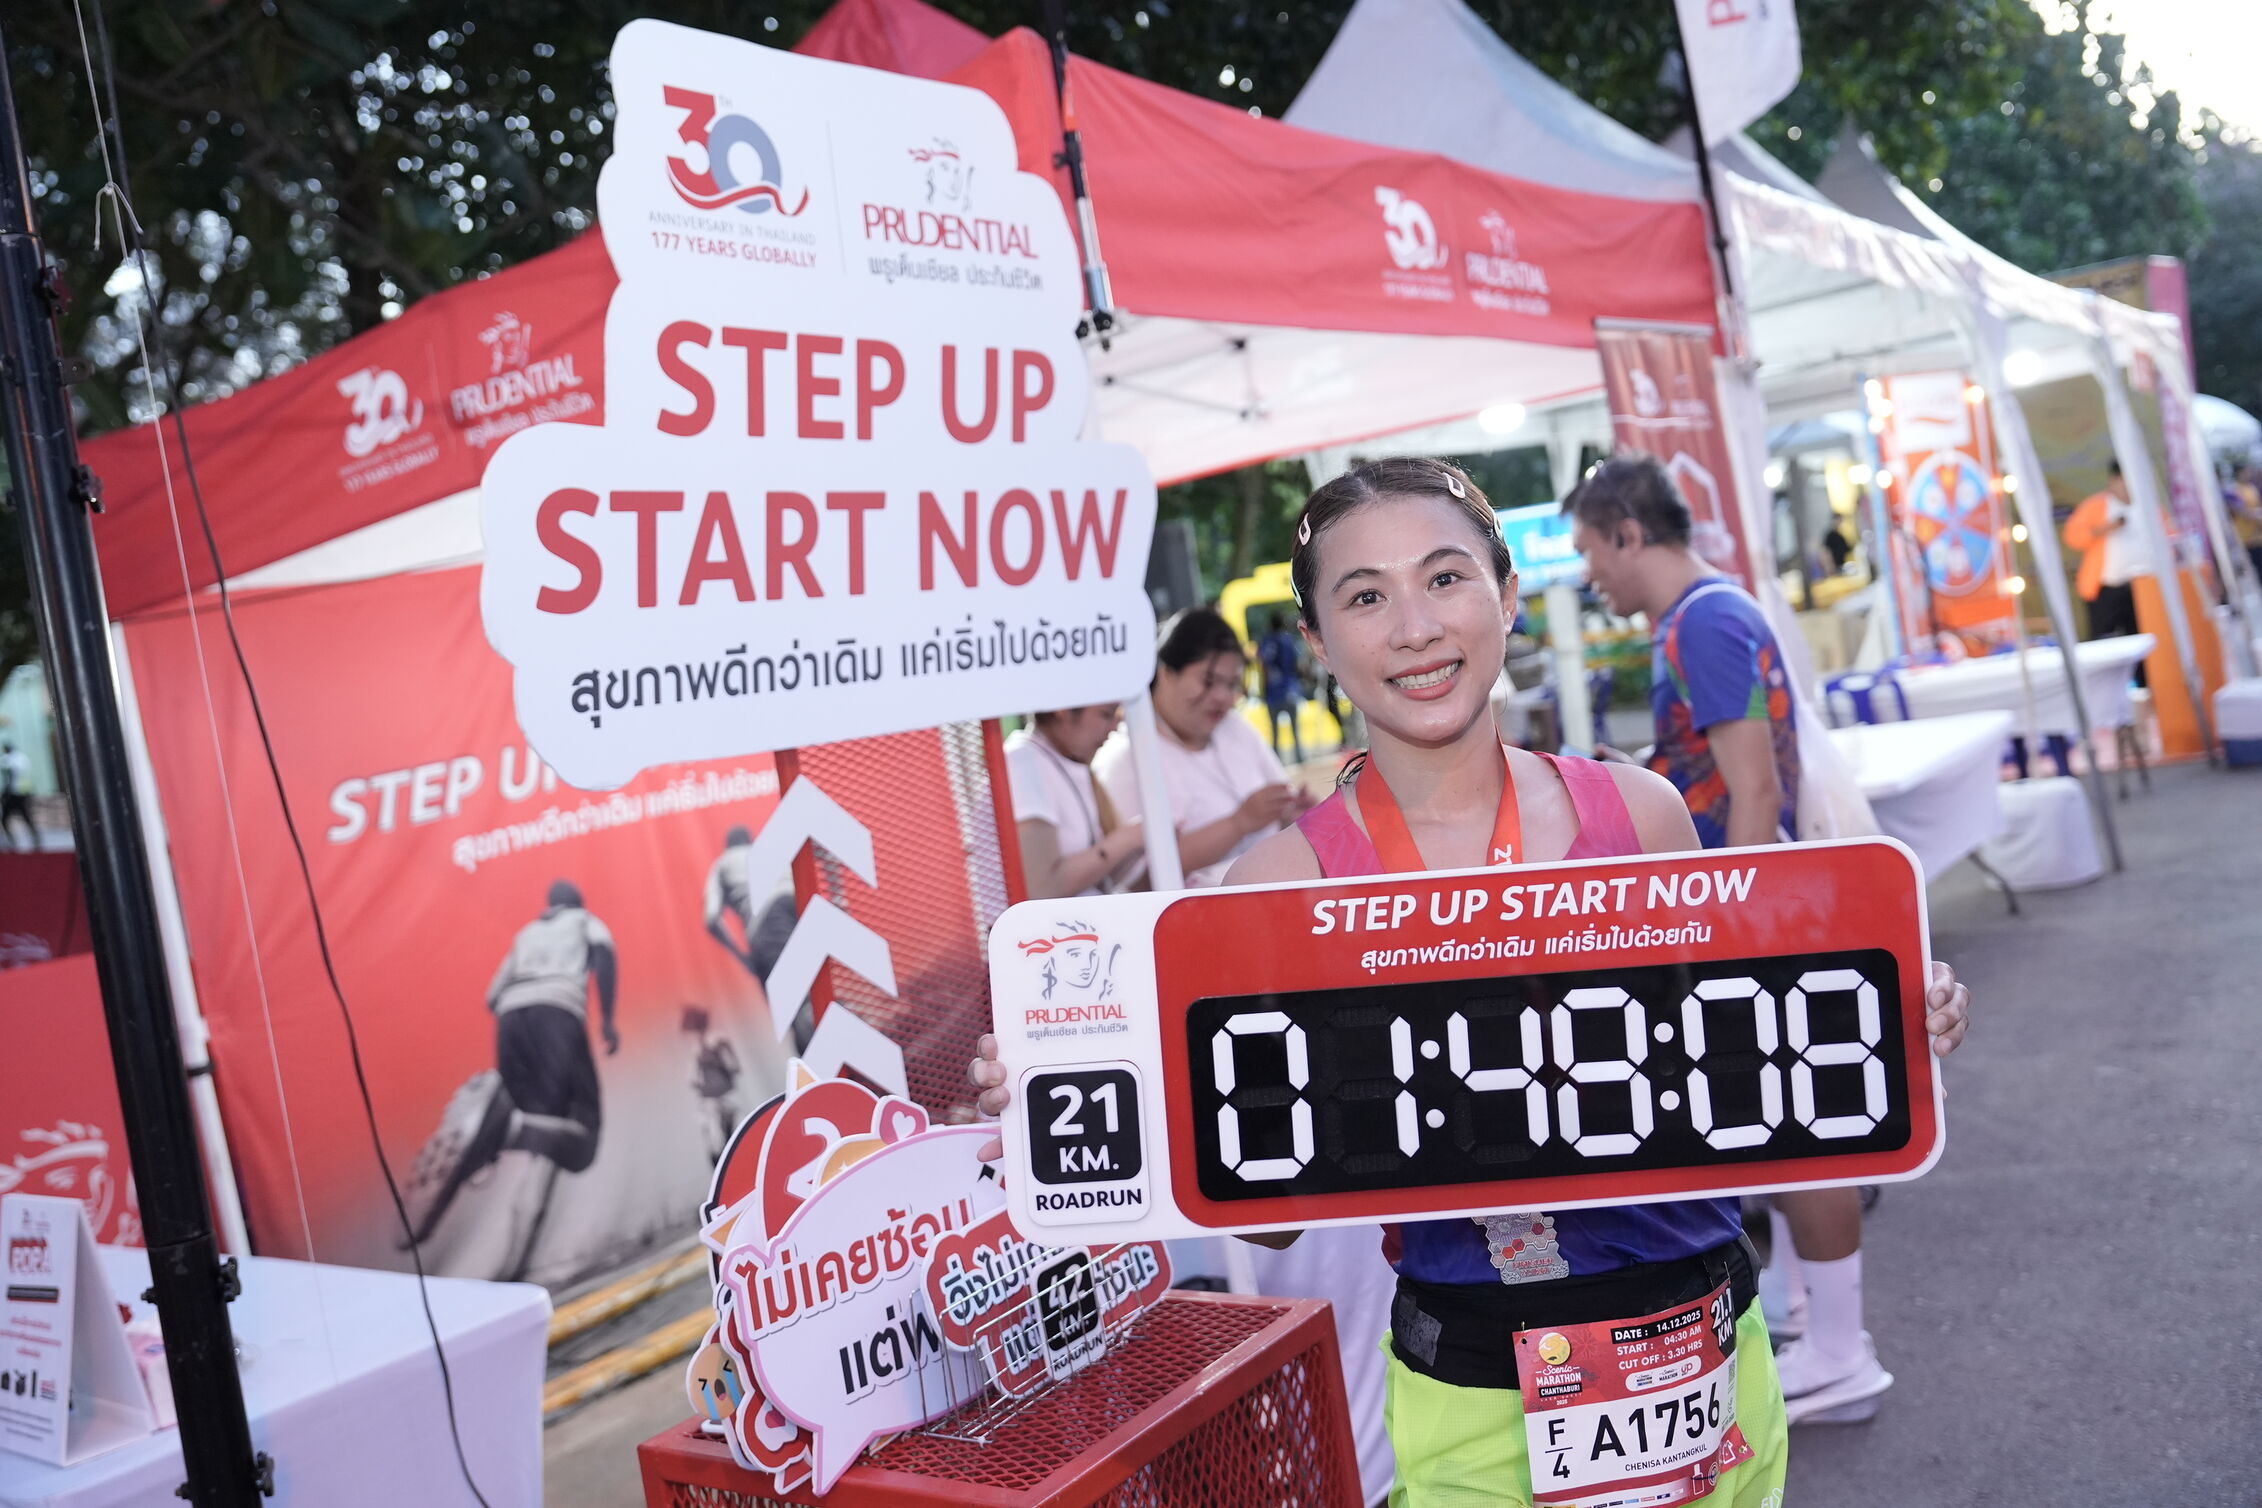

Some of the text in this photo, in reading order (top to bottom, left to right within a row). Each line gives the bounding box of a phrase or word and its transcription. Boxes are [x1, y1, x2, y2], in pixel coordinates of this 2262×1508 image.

[662, 84, 786, 214] 30
[650, 211, 816, 246] ANNIVERSARY IN THAILAND
[863, 203, 1040, 259] PRUDENTIAL
[652, 231, 817, 268] 177 YEARS GLOBALLY
[450, 353, 584, 423] PRUDENTIAL
[656, 319, 1056, 444] STEP UP
[535, 487, 1128, 616] START NOW
[570, 613, 1127, 729] สุขภาพดีกว่าเดิม แค่เริ่มไปด้วยกัน
[328, 755, 484, 844] STEP
[1311, 866, 1758, 935] STEP UP START NOW
[1360, 921, 1712, 975] สุขภาพดีกว่าเดิม แค่เริ่มไปด้วยกัน
[1025, 1003, 1128, 1024] PRUDENTIAL
[1026, 1023, 1129, 1041] พรูเด็นเชียล ประกันชีวิต
[1211, 967, 1889, 1182] 01:48:08
[1049, 1082, 1119, 1137] 21
[1058, 1144, 1120, 1174] KM.
[1035, 1188, 1143, 1211] ROADRUN
[1049, 1263, 1086, 1310] 42
[1614, 1328, 1642, 1341] DATE
[1656, 1309, 1701, 1333] 14.12.2025
[1710, 1287, 1733, 1330] 21.1
[1616, 1342, 1648, 1356] START
[1663, 1330, 1688, 1346] 04:30
[1689, 1324, 1702, 1337] AM
[1717, 1317, 1733, 1347] KM
[1053, 1334, 1103, 1372] ROADRUN
[1542, 1364, 1573, 1376] Scenic
[1618, 1359, 1639, 1370] CUT
[1641, 1354, 1660, 1366] OFF
[1667, 1346, 1686, 1360] 3.30
[1687, 1338, 1703, 1353] HRS
[1535, 1371, 1582, 1387] MARATHON
[1540, 1384, 1581, 1397] CHANTHABURI
[1548, 1418, 1566, 1446] F
[1589, 1382, 1721, 1462] A1756
[1552, 1453, 1571, 1479] 4
[1624, 1443, 1708, 1472] CHENISA KANTANGKUL
